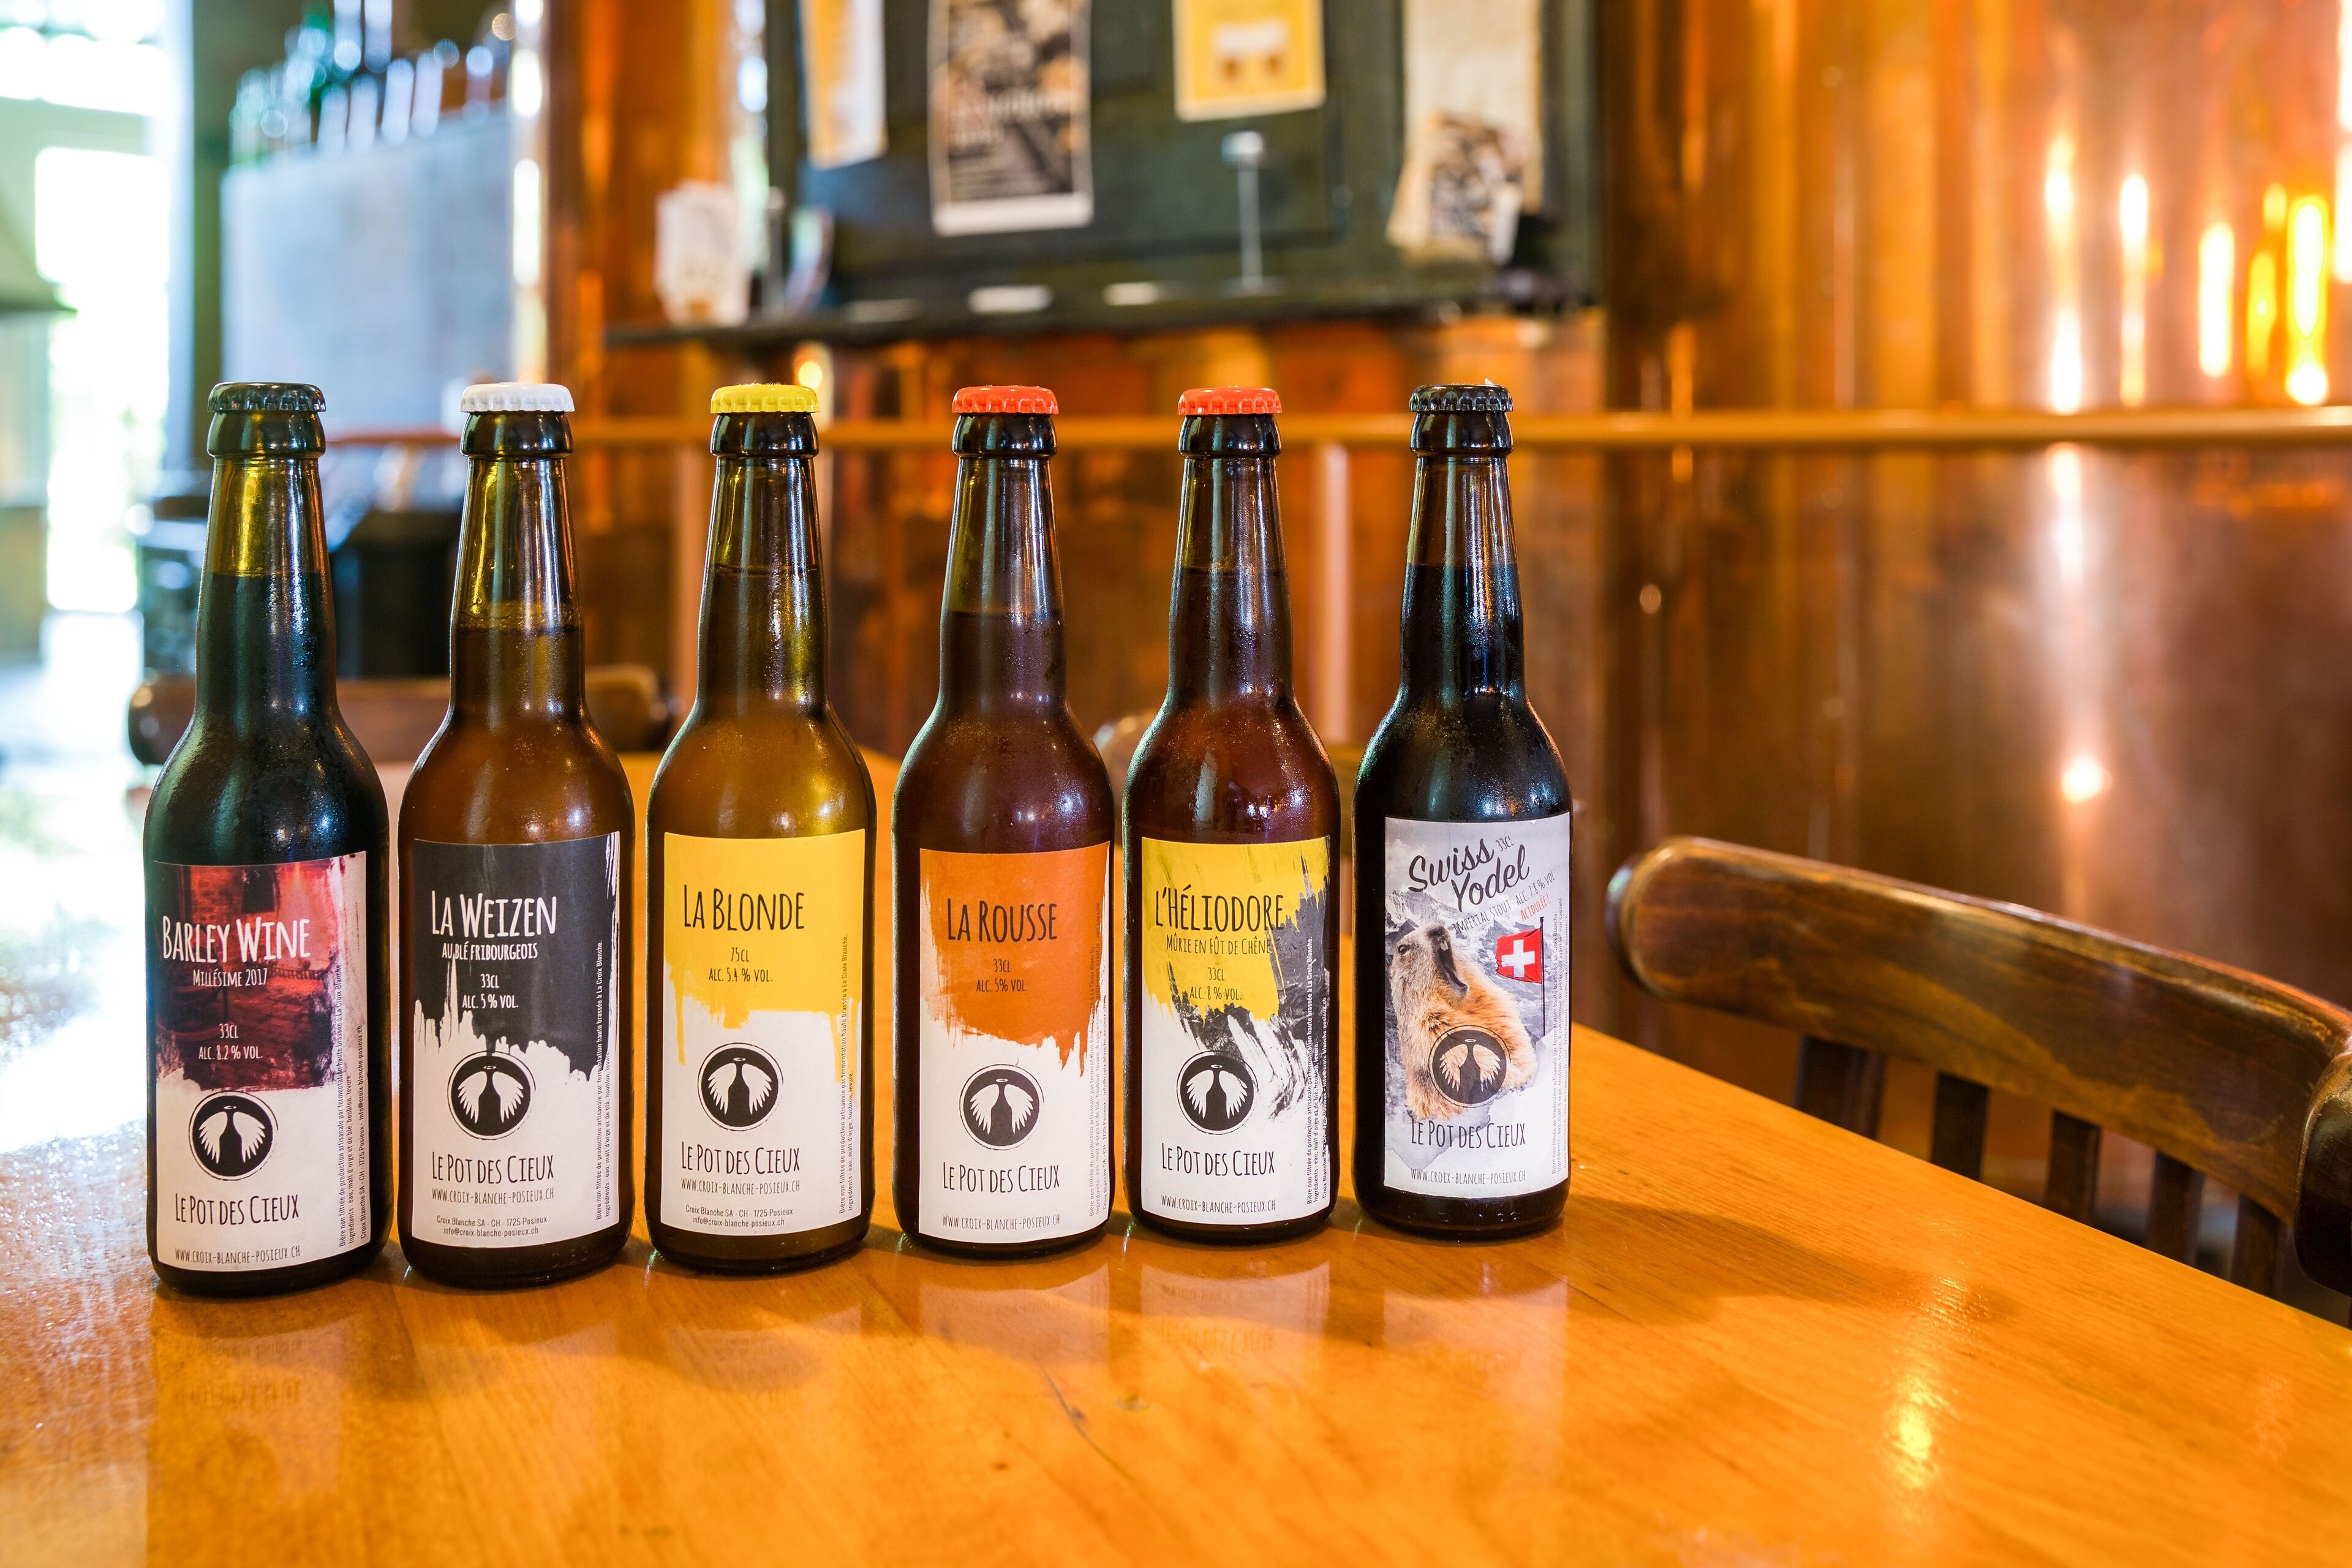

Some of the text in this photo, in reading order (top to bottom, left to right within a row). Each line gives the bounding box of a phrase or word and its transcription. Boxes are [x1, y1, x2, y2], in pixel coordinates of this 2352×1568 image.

[1408, 838, 1494, 892] Swiss
[1451, 845, 1529, 913] Yodel
[431, 891, 557, 937] LA WEIZEN
[684, 884, 804, 931] LA BLONDE
[948, 898, 1057, 943] LA ROUSSE
[163, 916, 311, 963] BARLEY WINE
[1166, 933, 1191, 953] MÛRIE
[1194, 940, 1207, 954] EN
[1209, 935, 1224, 954] FÛT
[1228, 941, 1238, 954] DE
[442, 941, 538, 960] AU BLÉ FRIBOURGEOIS
[731, 947, 749, 962] 75CL
[993, 958, 1011, 973] 33CL
[1208, 967, 1225, 981] 33CL
[193, 967, 268, 987] MILLÉSIME 2017
[481, 973, 499, 989] 33CL
[219, 1023, 239, 1039] 33CL
[1411, 1117, 1525, 1148] LE POT DES CIEUX
[682, 1141, 800, 1175] LE POT DES CIEUX
[1162, 1143, 1275, 1176] LE POT DES CIEUX
[359, 1171, 364, 1180] CH
[432, 1151, 554, 1184] LE POT DES CIEUX
[1411, 1167, 1526, 1184] WWW.CROIX-BLANCHE-POSIEUX.CH
[681, 1177, 800, 1194] WWW.CROIX-BLANCHE-POSIEUX.CH
[943, 1162, 1060, 1193] LE POT DES CIEUX
[360, 1186, 364, 1194] SA
[432, 1188, 554, 1204] WWW.CROIX-BLANCHE-POSIEUX.CH
[175, 1193, 299, 1225] LE POT DES CIEUX
[686, 1205, 699, 1215] Croix
[701, 1207, 723, 1216] Blanche
[1161, 1195, 1275, 1213] WWW.CROIX-BLANCHE-POSIEUX.CH
[437, 1215, 548, 1227] Croix Blanche SA CH 1725 Posieux
[692, 1216, 784, 1227] info@croix-blanche-posieux.ch
[942, 1214, 1060, 1230] WWW.CROIX-BLANCHE-POSIEUX.CH
[443, 1226, 538, 1237] info@croix-blanche-posieux.ch
[175, 1245, 300, 1264] WWW.CROIX-BLANCHE-POSIEUX.CH
